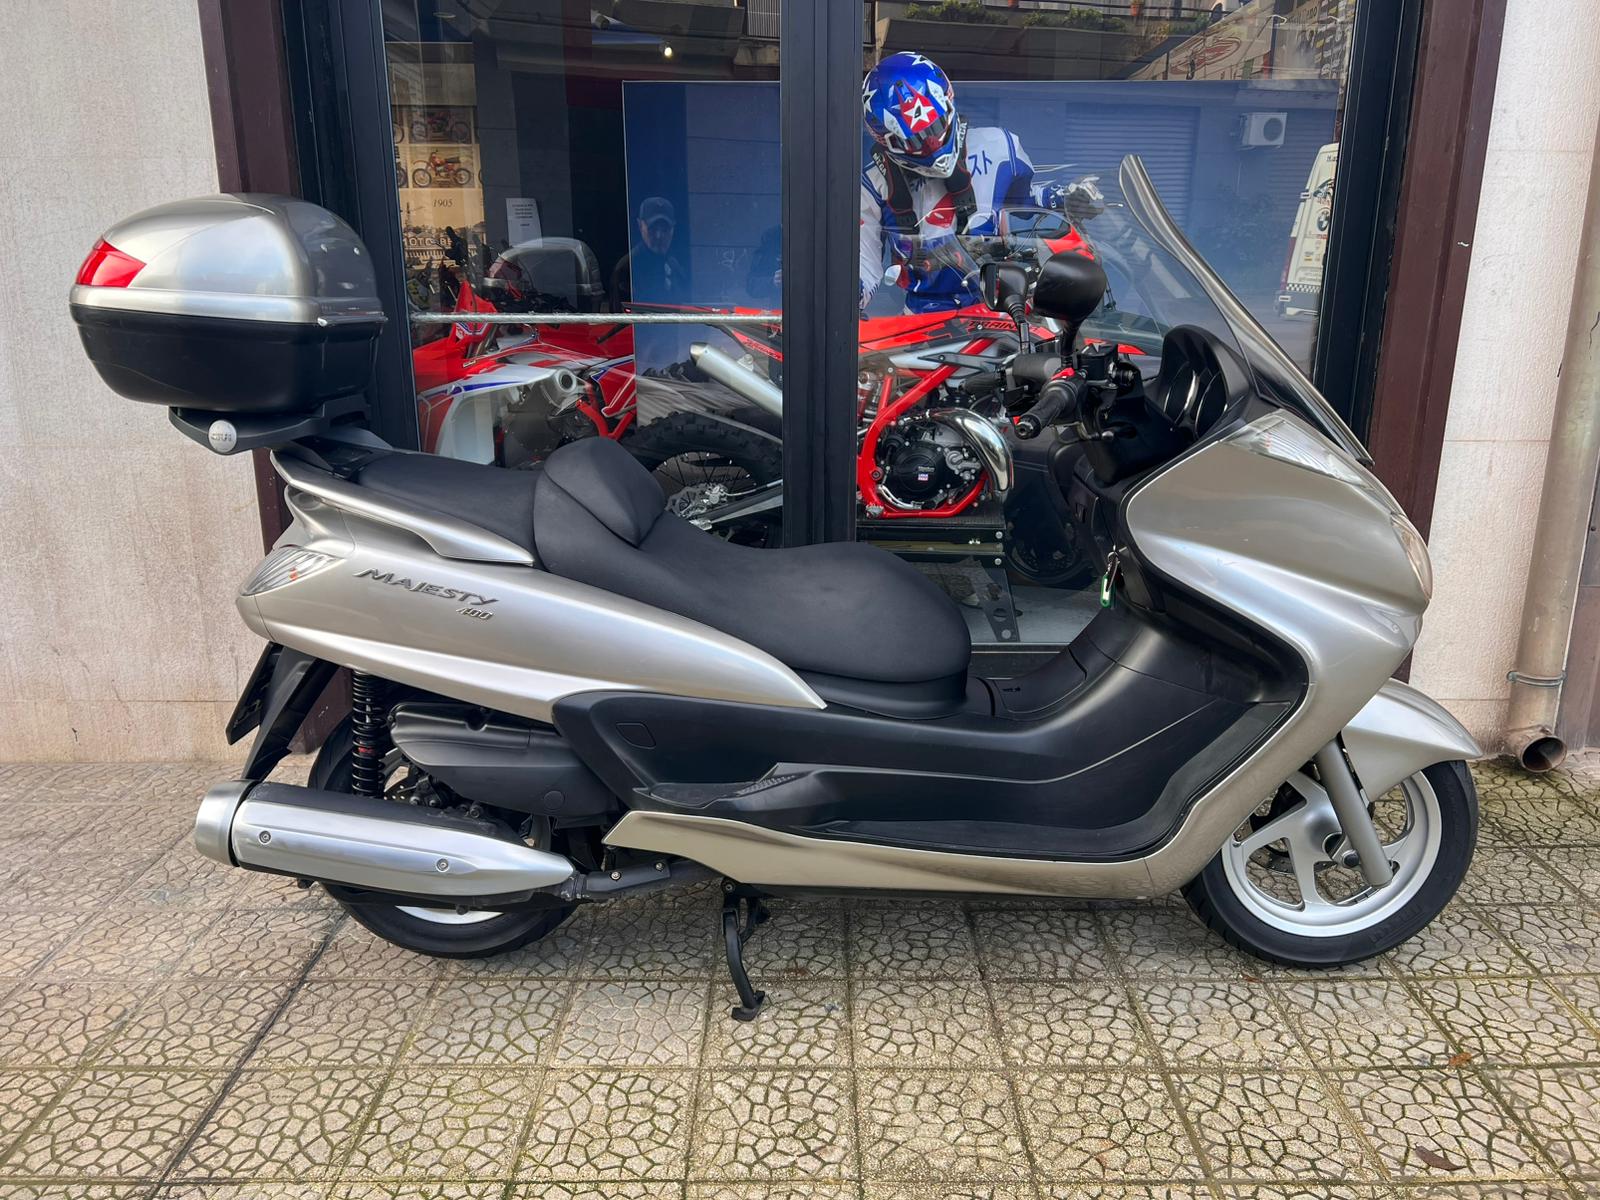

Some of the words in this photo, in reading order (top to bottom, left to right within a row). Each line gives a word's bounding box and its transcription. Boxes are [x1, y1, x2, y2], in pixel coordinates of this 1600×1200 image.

[433, 198, 453, 208] 1905
[352, 567, 500, 606] MAJESTY
[455, 606, 495, 622] 400
